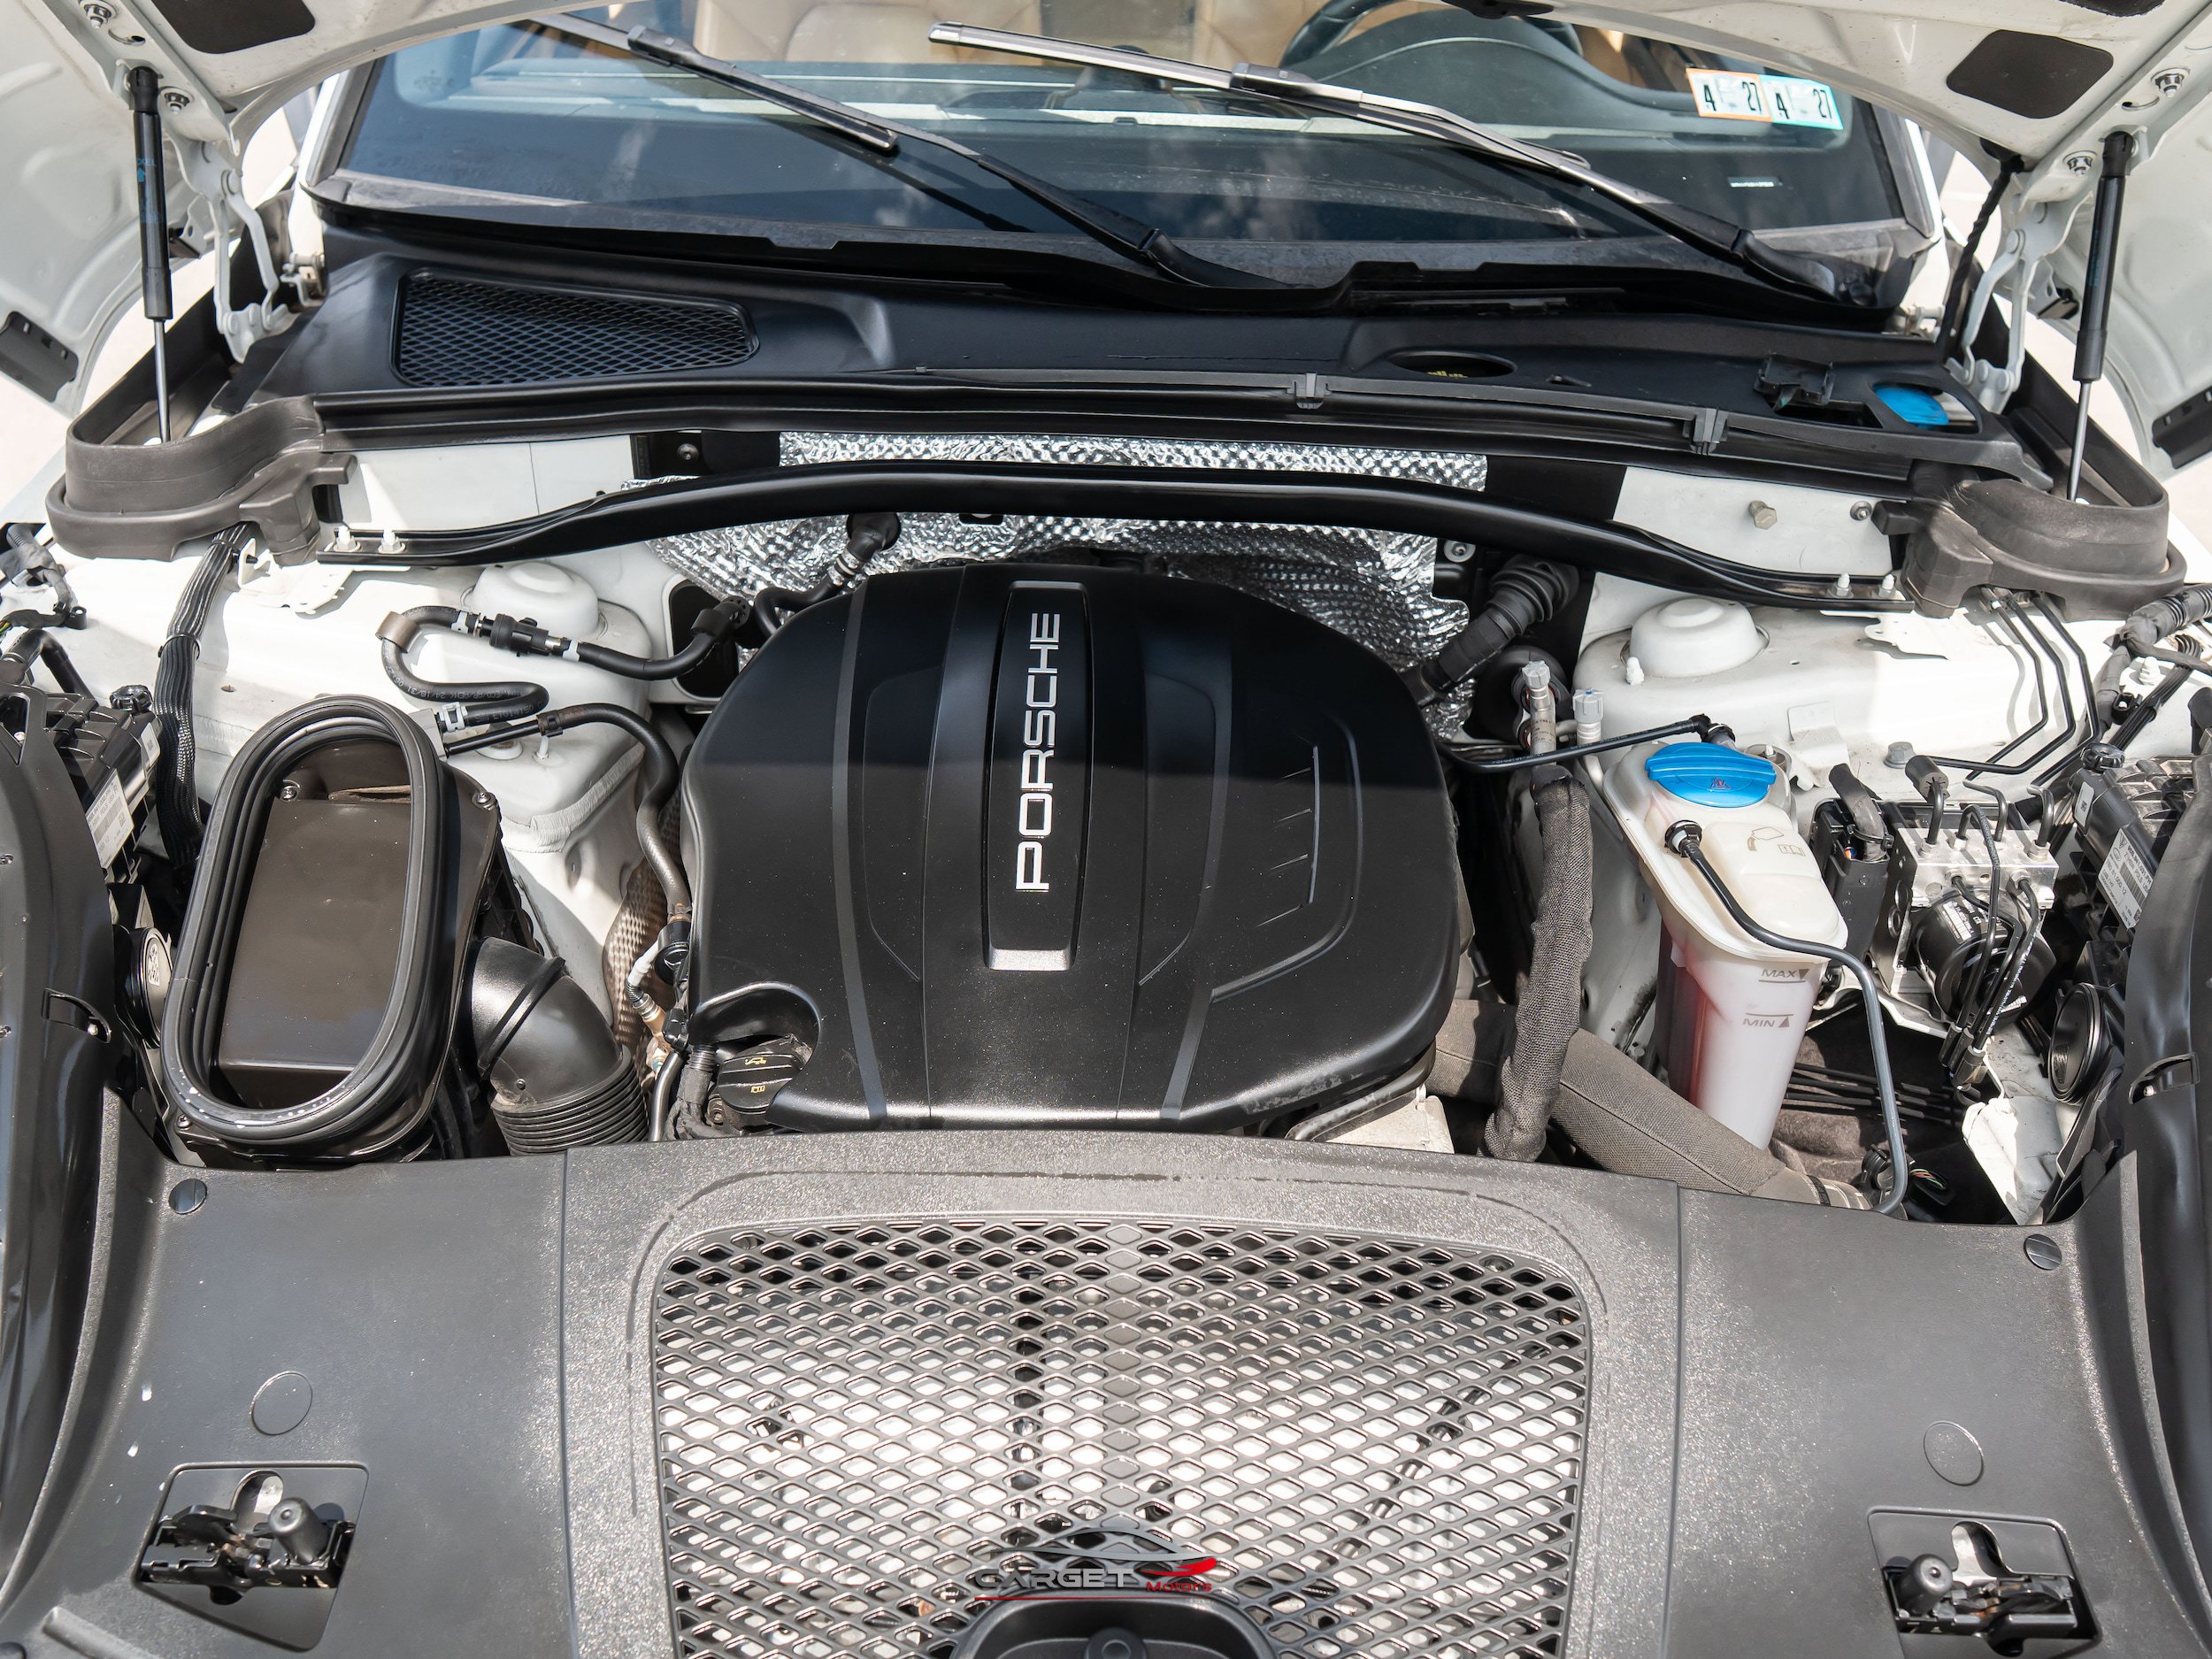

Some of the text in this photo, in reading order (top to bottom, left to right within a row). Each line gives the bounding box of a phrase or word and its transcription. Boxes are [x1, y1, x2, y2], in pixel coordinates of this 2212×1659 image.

[1703, 84, 1717, 112] 4
[1775, 92, 1790, 119] 4
[1016, 612, 1061, 893] PORSCHE
[1762, 969, 1797, 978] MAX
[1742, 1018, 1776, 1027] MIN
